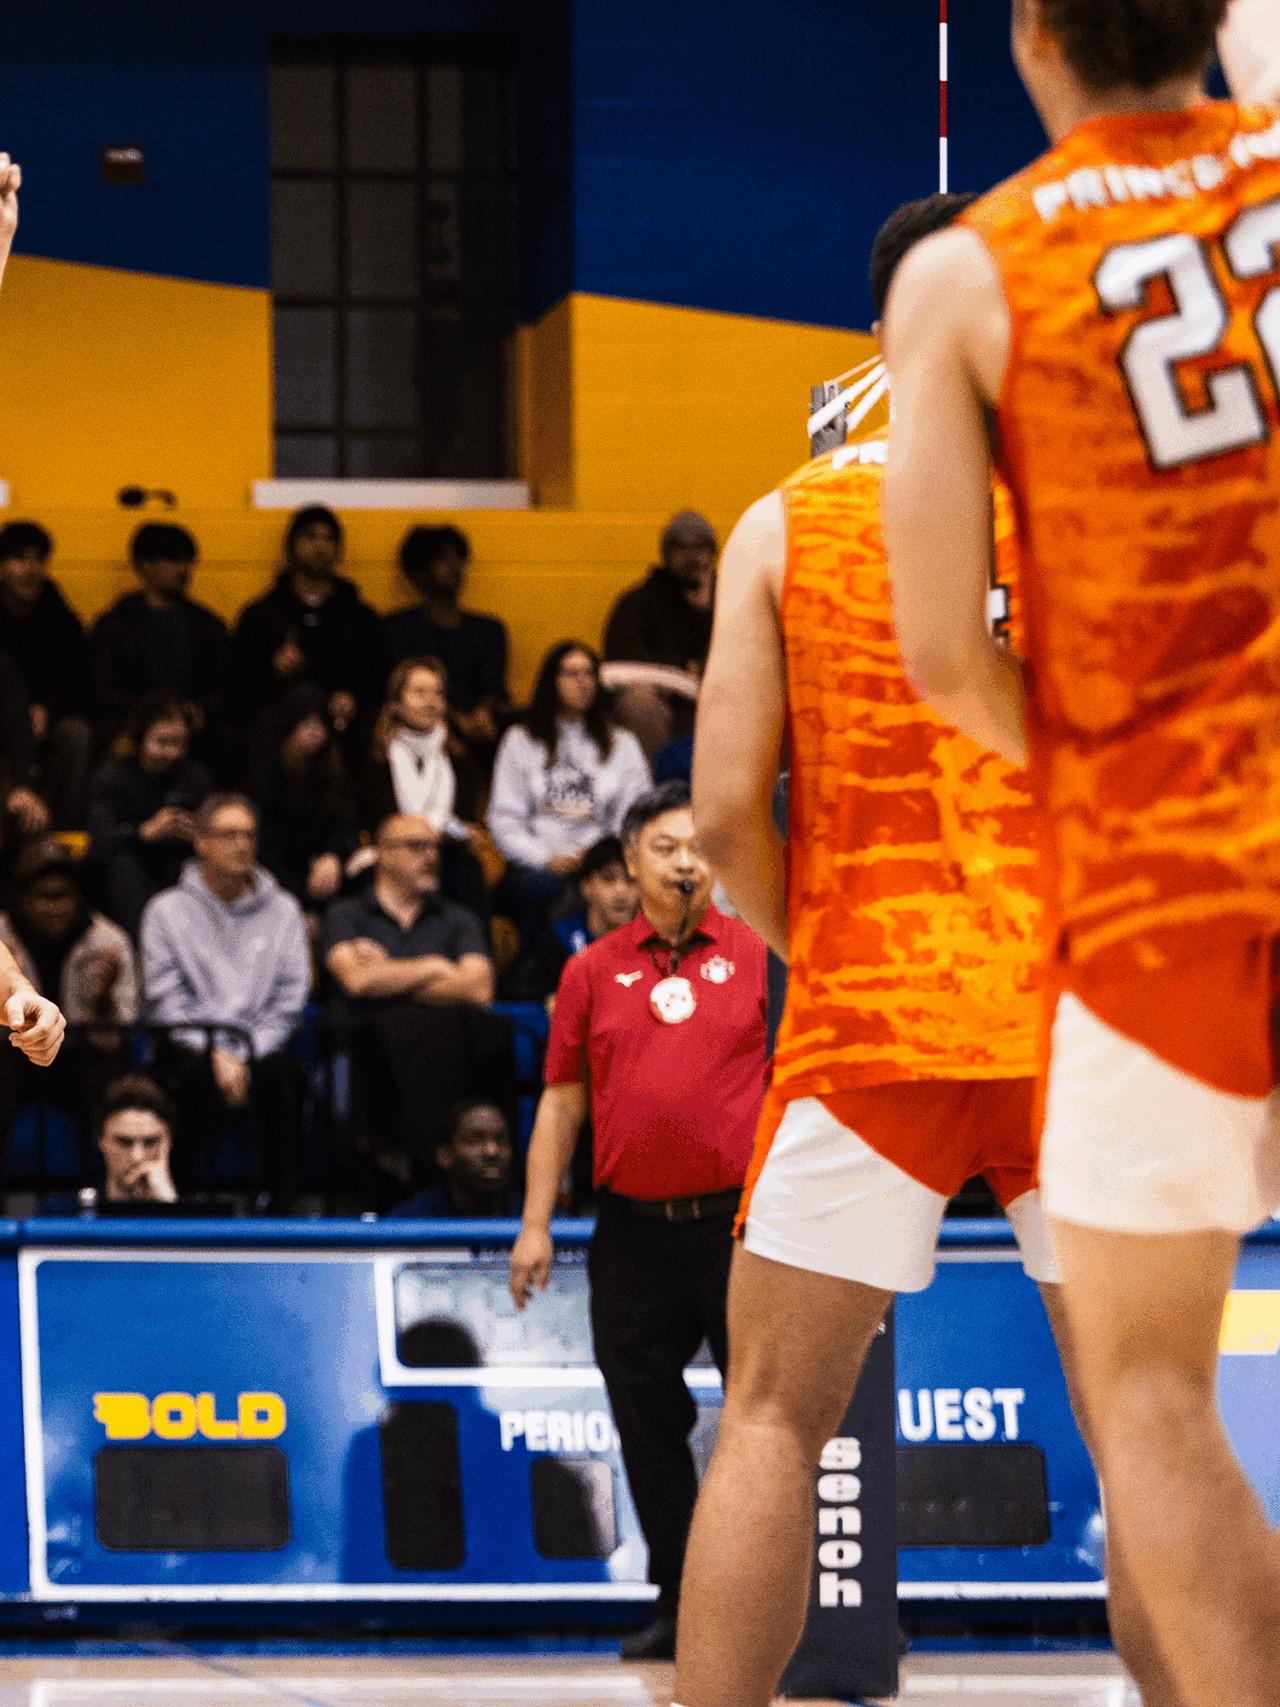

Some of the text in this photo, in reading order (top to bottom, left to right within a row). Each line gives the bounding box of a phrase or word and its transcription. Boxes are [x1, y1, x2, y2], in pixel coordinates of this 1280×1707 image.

[93, 1391, 286, 1440] BOLD
[499, 1410, 620, 1452] PERIO
[896, 1386, 1026, 1442] UEST
[817, 1436, 862, 1608] senoh
